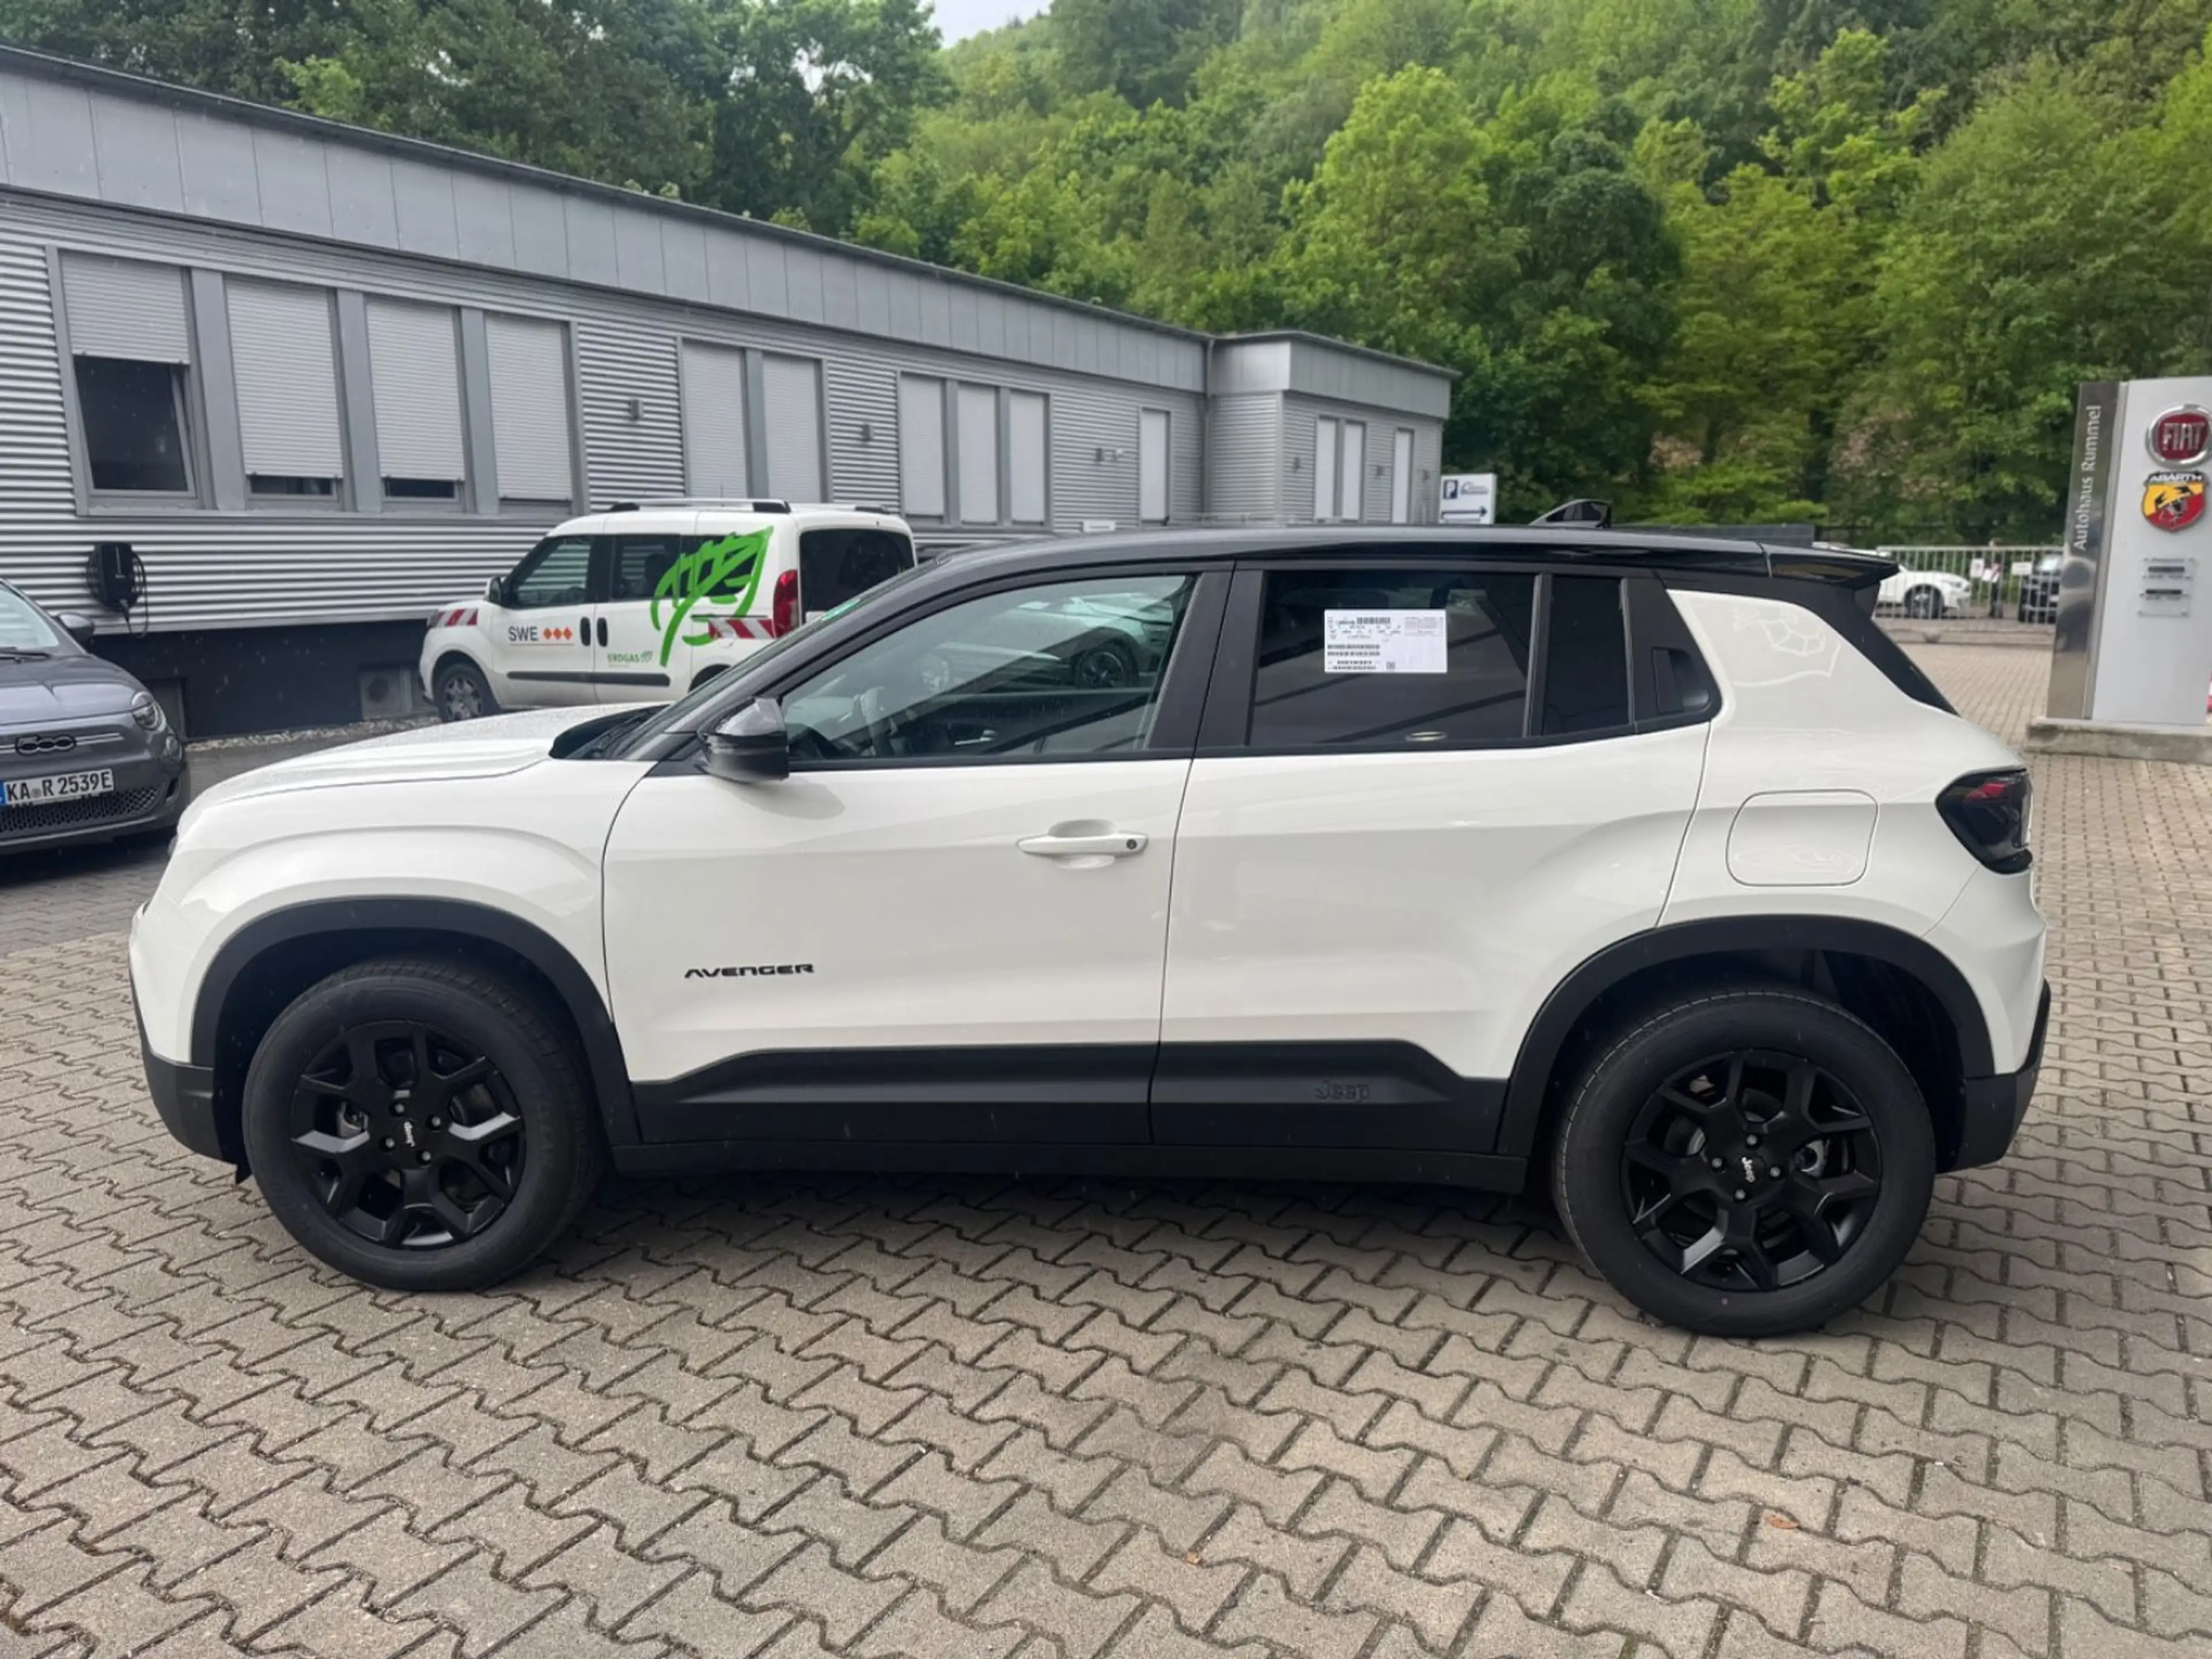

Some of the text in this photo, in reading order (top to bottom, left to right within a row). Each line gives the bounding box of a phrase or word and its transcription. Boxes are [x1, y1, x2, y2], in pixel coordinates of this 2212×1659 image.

[2162, 422, 2205, 451] FIAT
[2074, 404, 2102, 551] Autohaus Rummel
[2149, 474, 2203, 482] ABARTH
[1445, 480, 1457, 499] P
[508, 626, 539, 642] SWE
[16, 734, 75, 755] 500
[6, 771, 113, 801] KA R 2539E
[684, 963, 815, 979] AVENGER
[1313, 1080, 1370, 1103] Jeep
